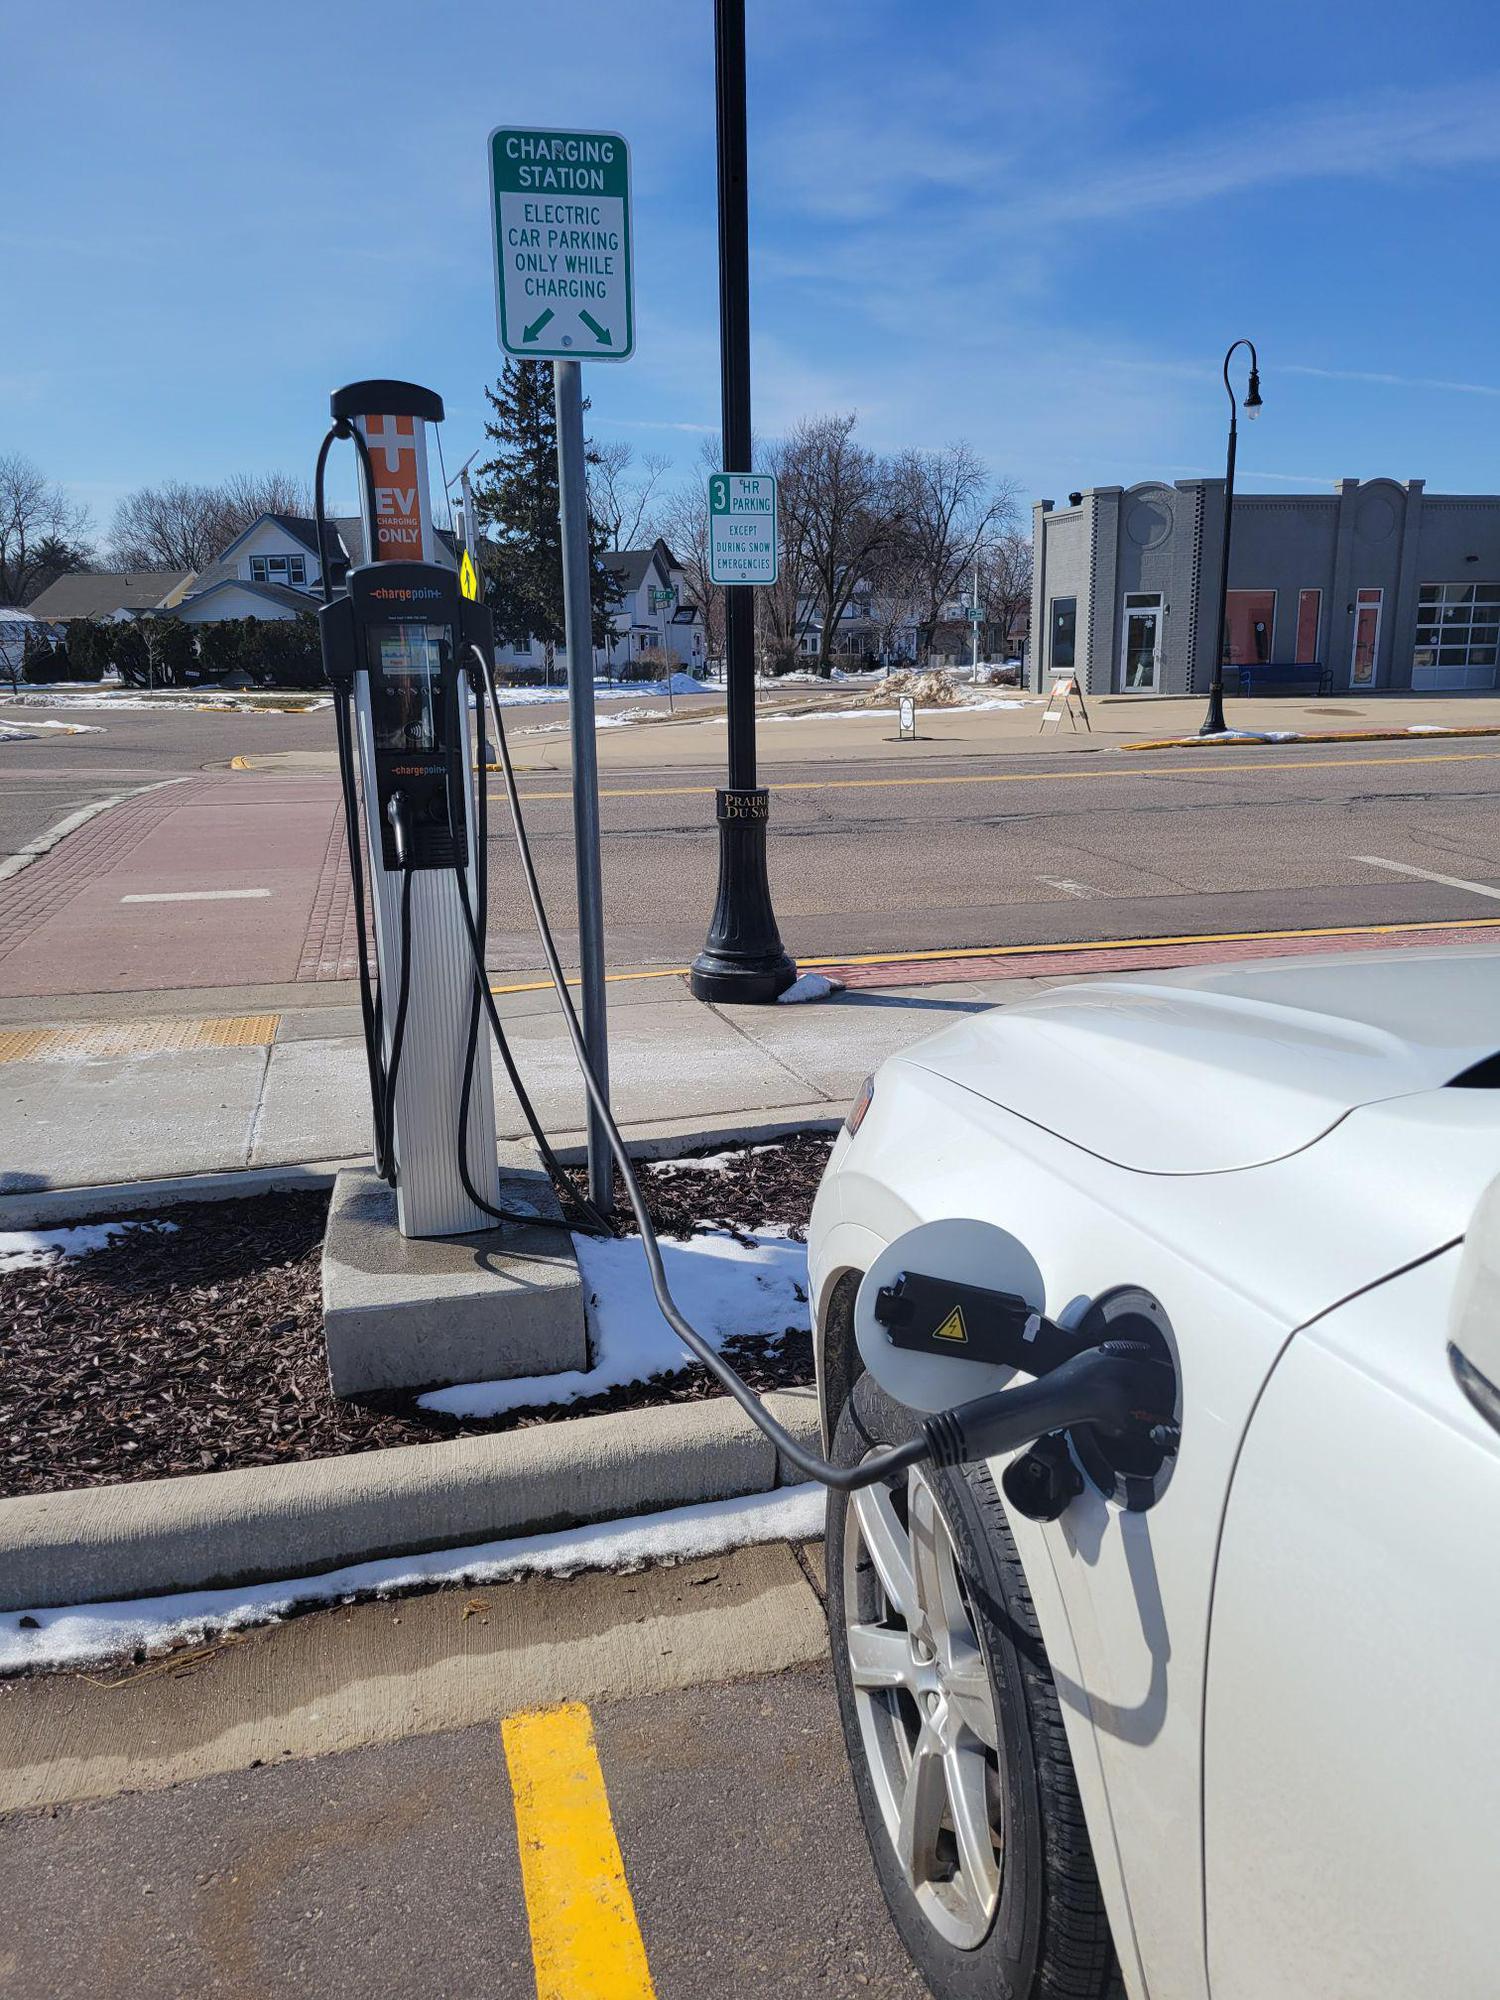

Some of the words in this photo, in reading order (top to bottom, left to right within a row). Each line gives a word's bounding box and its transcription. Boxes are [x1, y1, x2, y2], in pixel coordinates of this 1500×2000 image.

[506, 137, 614, 164] CHARGING
[519, 166, 604, 190] STATION
[524, 204, 601, 225] ELECTRIC
[508, 228, 541, 248] CAR
[549, 230, 619, 251] PARKING
[515, 253, 558, 273] ONLY
[565, 256, 614, 276] WHILE
[524, 278, 607, 299] CHARGING
[714, 480, 726, 510] 3
[743, 480, 760, 494] HR
[374, 487, 417, 515] EV
[733, 497, 771, 511] PARKING
[376, 517, 418, 526] CHARGING
[729, 525, 758, 536] EXCEPT
[378, 529, 420, 544] ONLY
[716, 542, 746, 553] DURING
[748, 542, 770, 553] SNOW
[717, 559, 770, 570] EMERGENCIES
